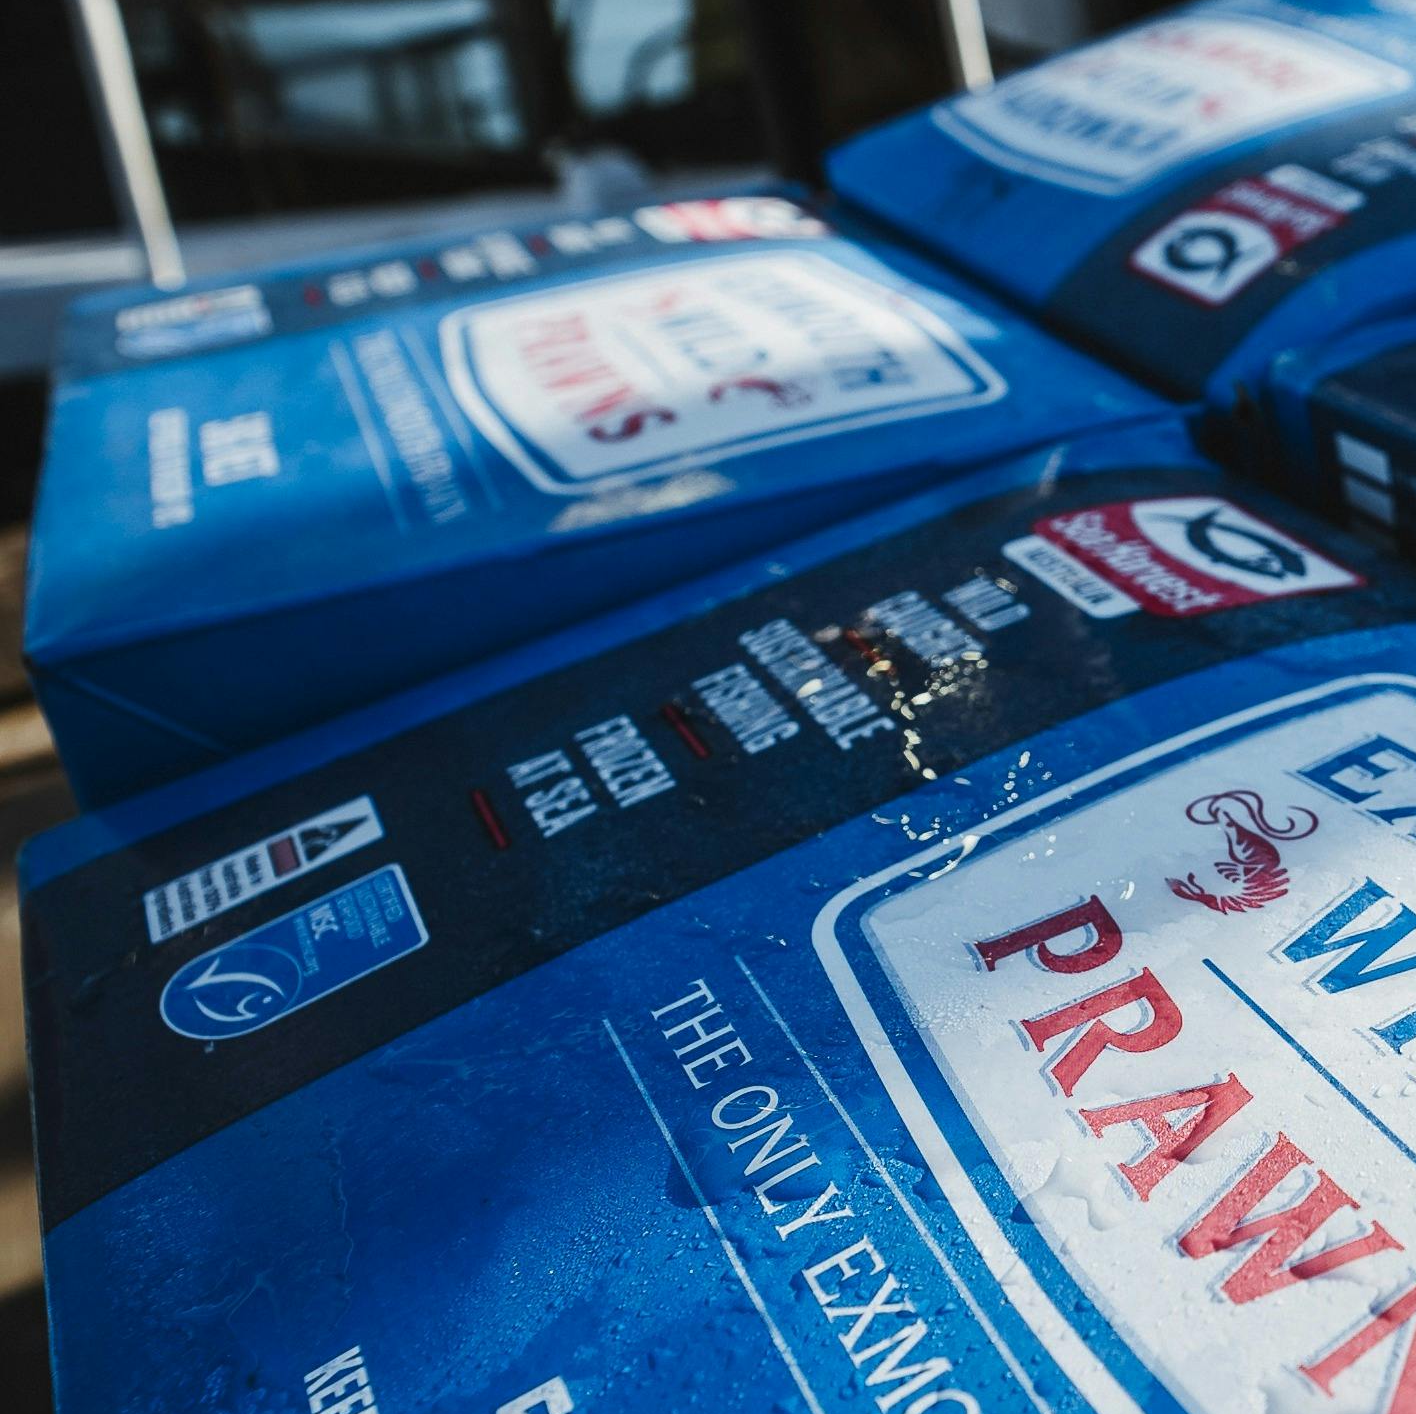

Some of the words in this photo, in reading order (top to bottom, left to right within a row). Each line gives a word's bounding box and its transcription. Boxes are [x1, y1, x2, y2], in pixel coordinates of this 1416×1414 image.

[691, 662, 801, 755] FISHING
[506, 748, 574, 790] AT
[524, 774, 598, 840] SEA
[574, 713, 677, 810] FROZEN
[649, 978, 726, 1090] THE
[711, 1084, 856, 1241] ONLY
